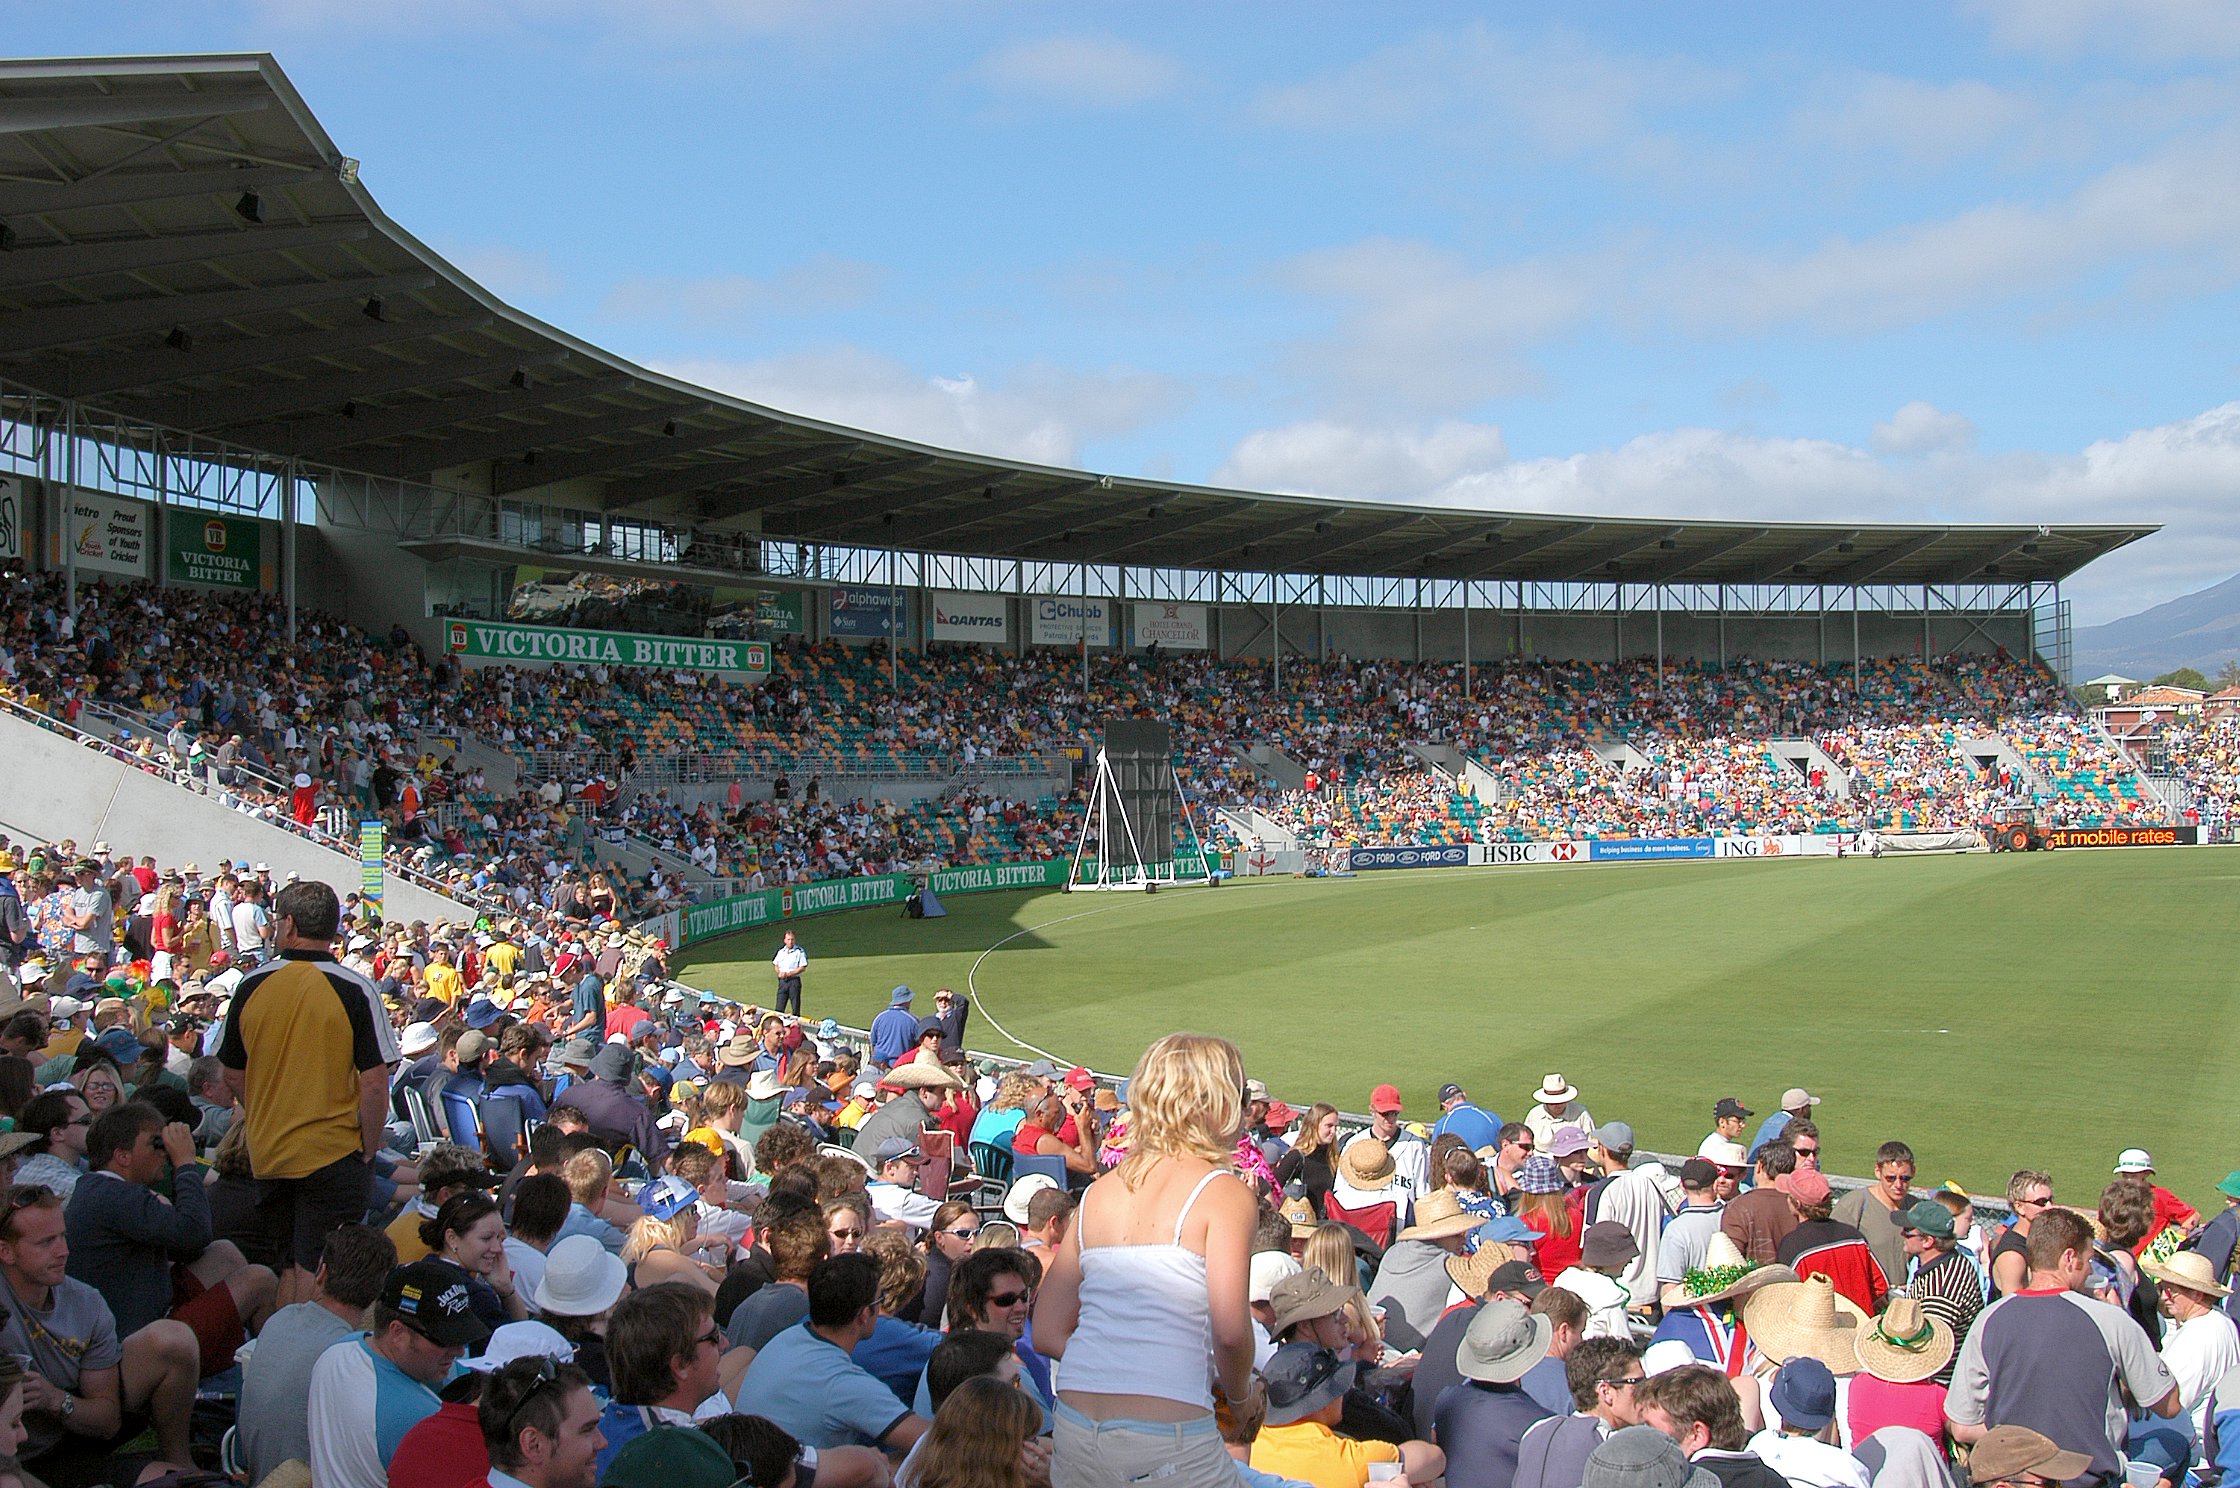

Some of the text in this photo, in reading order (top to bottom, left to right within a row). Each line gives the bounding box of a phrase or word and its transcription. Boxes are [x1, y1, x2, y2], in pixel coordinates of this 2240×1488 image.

[113, 509, 136, 523] Proud
[107, 522, 142, 538] Sponsors
[209, 530, 222, 543] VB
[109, 537, 140, 551] of Youth
[110, 550, 138, 564] Cricket
[181, 551, 250, 571] VICTORIA
[189, 566, 243, 583] BITTER
[949, 615, 1003, 627] QANTAS
[453, 631, 465, 643] VB
[475, 628, 738, 668] VICTORIA BITTER
[751, 653, 762, 663] VB
[2070, 829, 2128, 845] mobile
[2131, 828, 2176, 844] rates
[1483, 845, 1536, 862] HSBC
[1600, 846, 1620, 854] Helping
[1724, 841, 1757, 856] ING
[1376, 853, 1395, 863] FORD
[1421, 851, 1440, 861] FORD
[933, 865, 1046, 892] VICTORIA BITTER
[795, 880, 895, 912] VICTORIA BITTER
[690, 905, 729, 936] VICTORIA
[731, 898, 767, 925] BITTER
